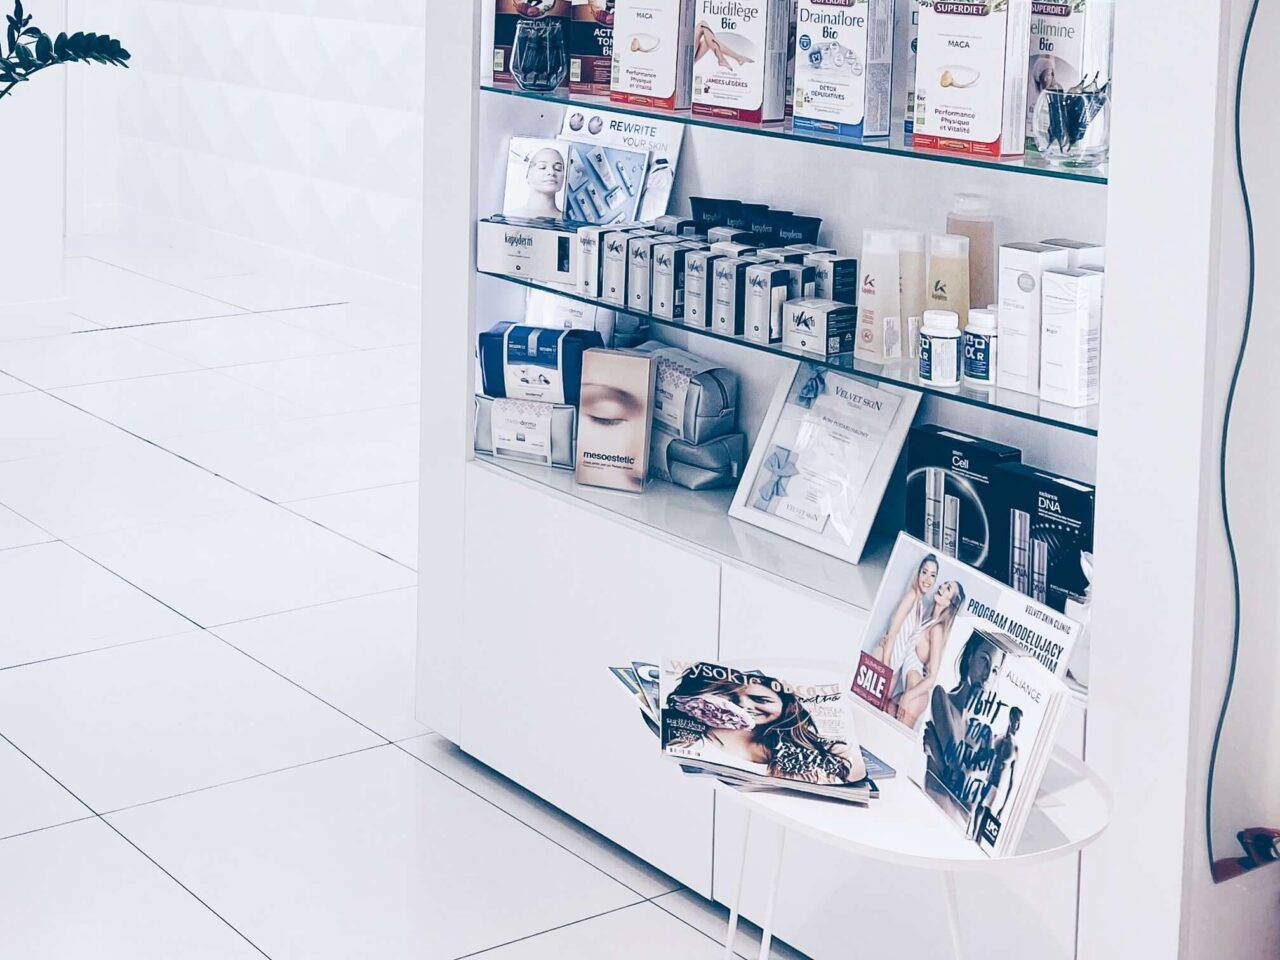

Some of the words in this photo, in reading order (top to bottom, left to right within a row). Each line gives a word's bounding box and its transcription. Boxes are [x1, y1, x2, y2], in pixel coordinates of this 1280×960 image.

[702, 1, 759, 23] Fluidilège
[936, 3, 984, 15] SUPERDIET
[721, 17, 737, 30] Bio
[799, 8, 865, 28] Drainaflore
[822, 26, 839, 39] Bio
[1031, 18, 1075, 39] ellimine
[602, 46, 613, 56] Bi
[947, 40, 970, 49] MACA
[1039, 37, 1054, 52] Bio
[934, 108, 976, 119] Performance
[609, 120, 657, 138] REWRITE
[622, 136, 646, 150] YOUR
[646, 140, 668, 153] SKIN
[835, 386, 863, 405] VELVET
[862, 399, 883, 412] SKIN
[583, 451, 635, 465] mesoestetic
[952, 455, 969, 469] Cell
[1038, 496, 1062, 513] DNA
[967, 598, 1009, 631] PROGRAM
[1025, 604, 1043, 620] VELVET
[1042, 613, 1054, 626] SKIN
[1053, 619, 1072, 635] CLINIC
[856, 664, 887, 699] SALE
[1006, 670, 1042, 704] ALLIANCE
[966, 689, 1009, 724] IGHT
